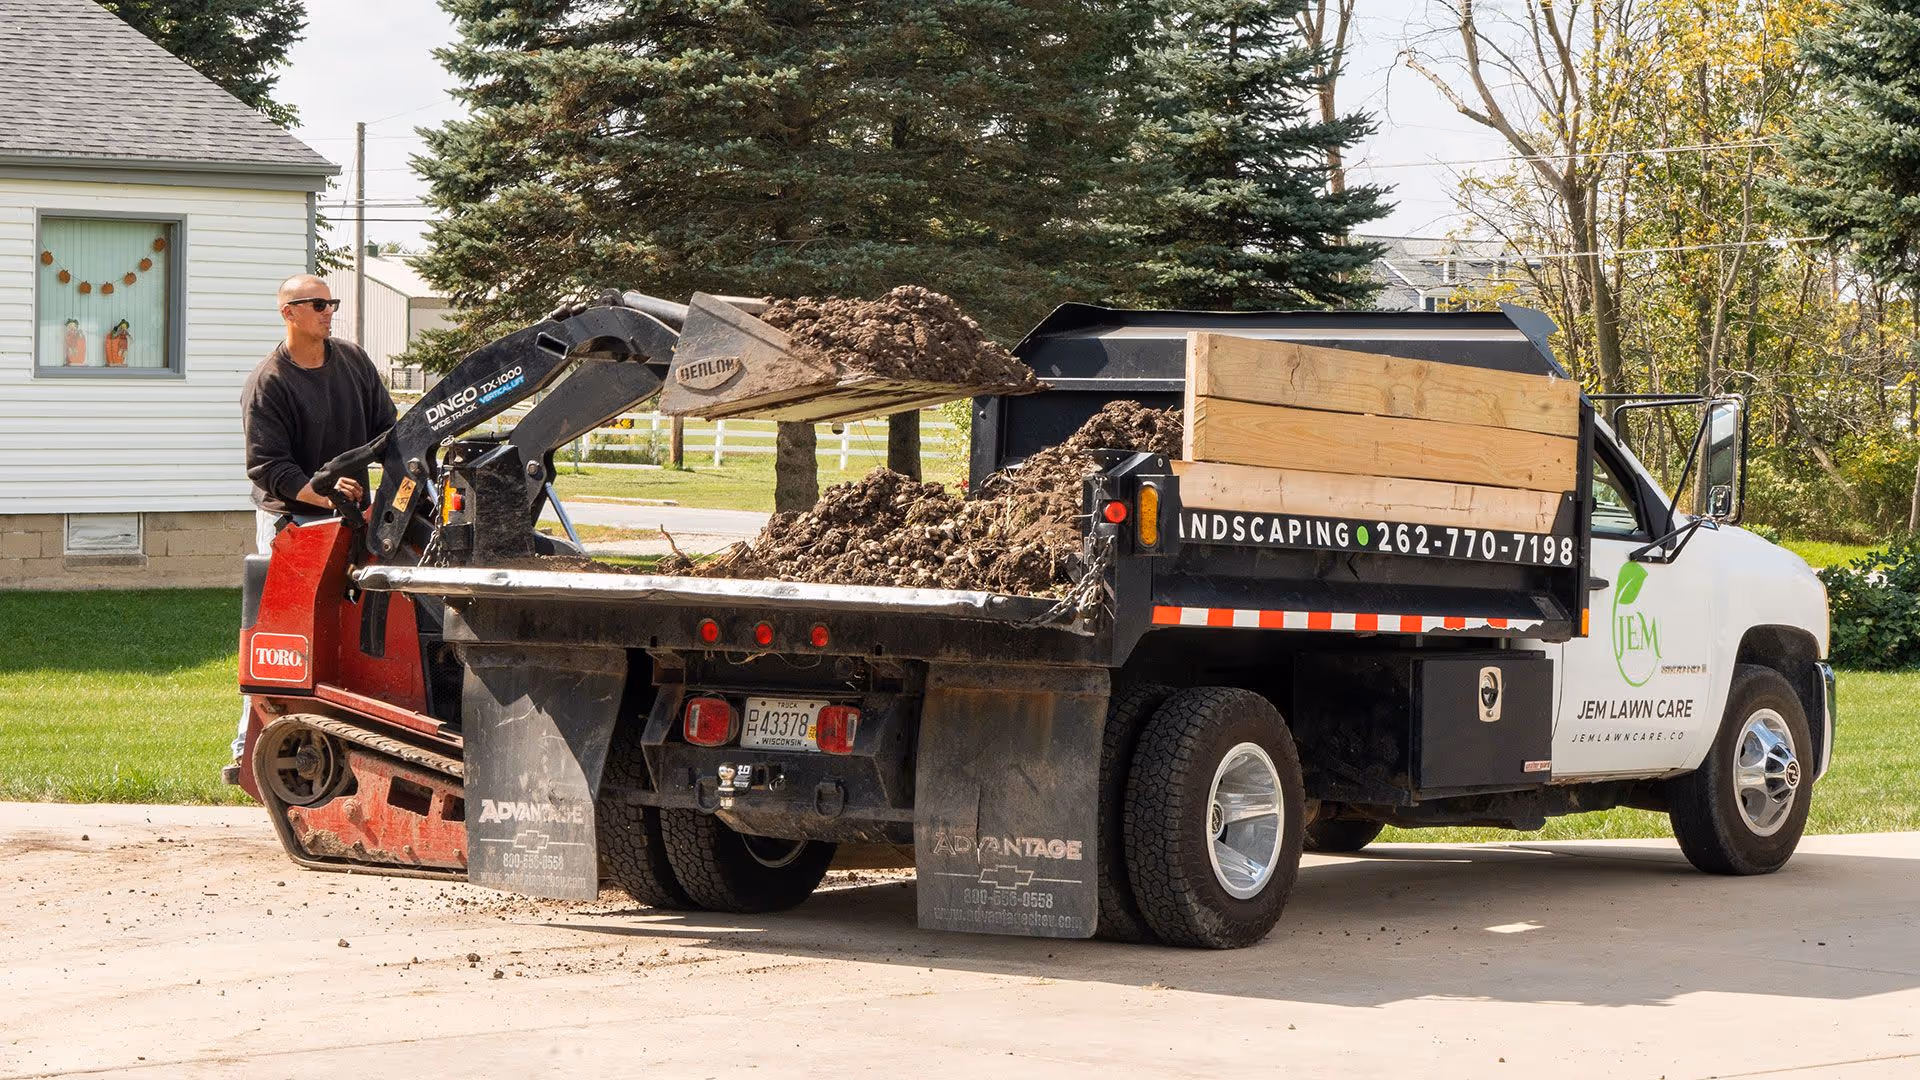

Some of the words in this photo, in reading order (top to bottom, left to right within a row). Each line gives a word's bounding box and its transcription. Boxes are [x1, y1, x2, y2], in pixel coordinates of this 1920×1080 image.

[480, 384, 513, 404] VERTICAL
[511, 375, 525, 388] LIFT
[425, 386, 478, 424] DINGO
[431, 418, 452, 432] WIDE
[452, 403, 478, 421] TRACK
[1376, 521, 1574, 566] 262-770-7198
[1617, 611, 1663, 661] JEM
[1576, 700, 1607, 720] JEM
[1609, 700, 1654, 719] LAWN
[1656, 699, 1693, 718] CARE
[760, 711, 809, 737] 43378
[1571, 731, 1684, 743] JEMLAWNCARE.CO
[761, 737, 802, 747] WISCONSIN
[478, 799, 584, 824] ADVANTAGE
[933, 832, 1083, 861] ADVANTAGE
[963, 887, 1054, 909] 800-556-0558
